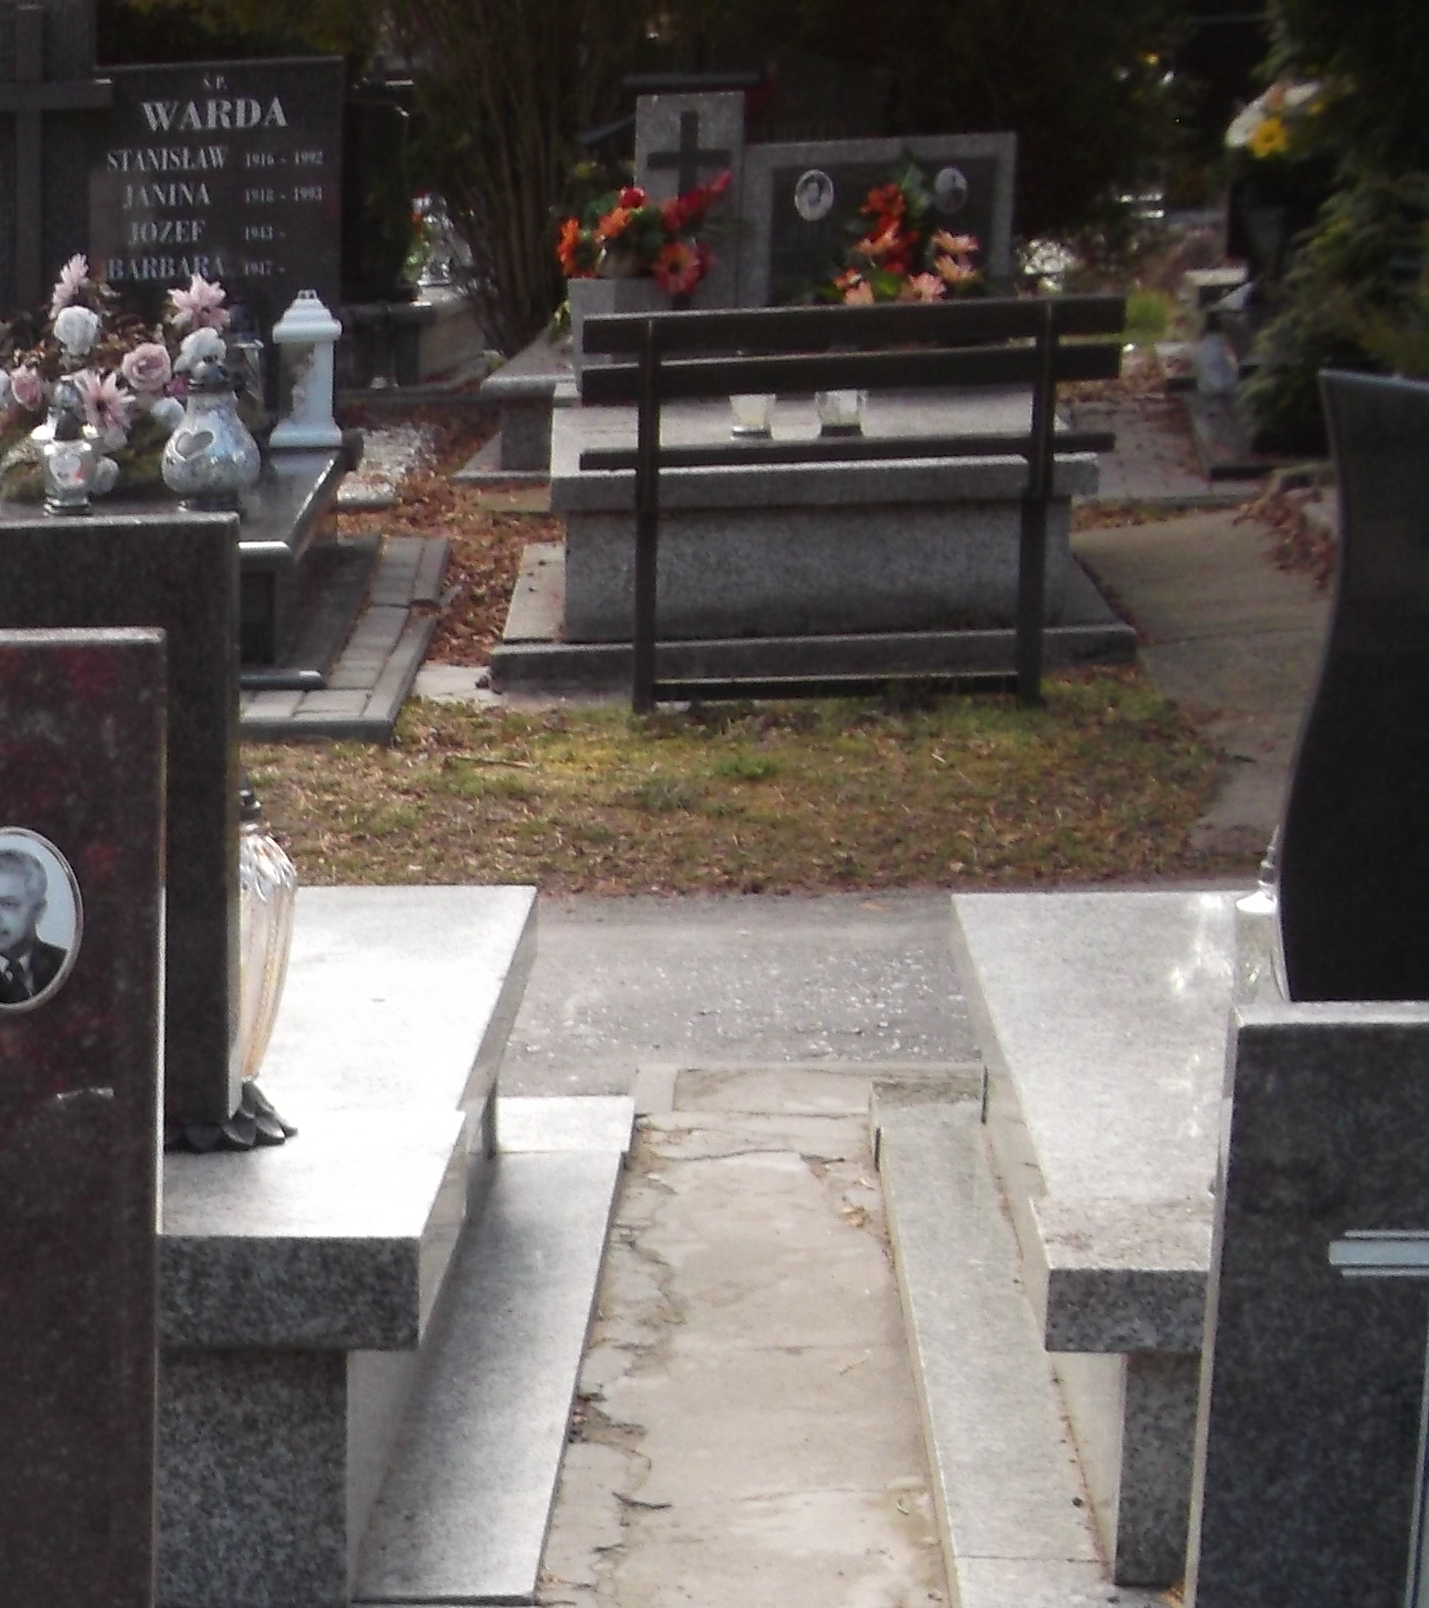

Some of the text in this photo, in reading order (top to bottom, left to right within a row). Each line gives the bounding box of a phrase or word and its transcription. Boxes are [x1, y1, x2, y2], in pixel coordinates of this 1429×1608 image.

[140, 96, 290, 133] WARDA
[106, 145, 228, 173] STANISŁAW
[122, 181, 211, 210] JANINA
[107, 254, 227, 281] BARBARA
